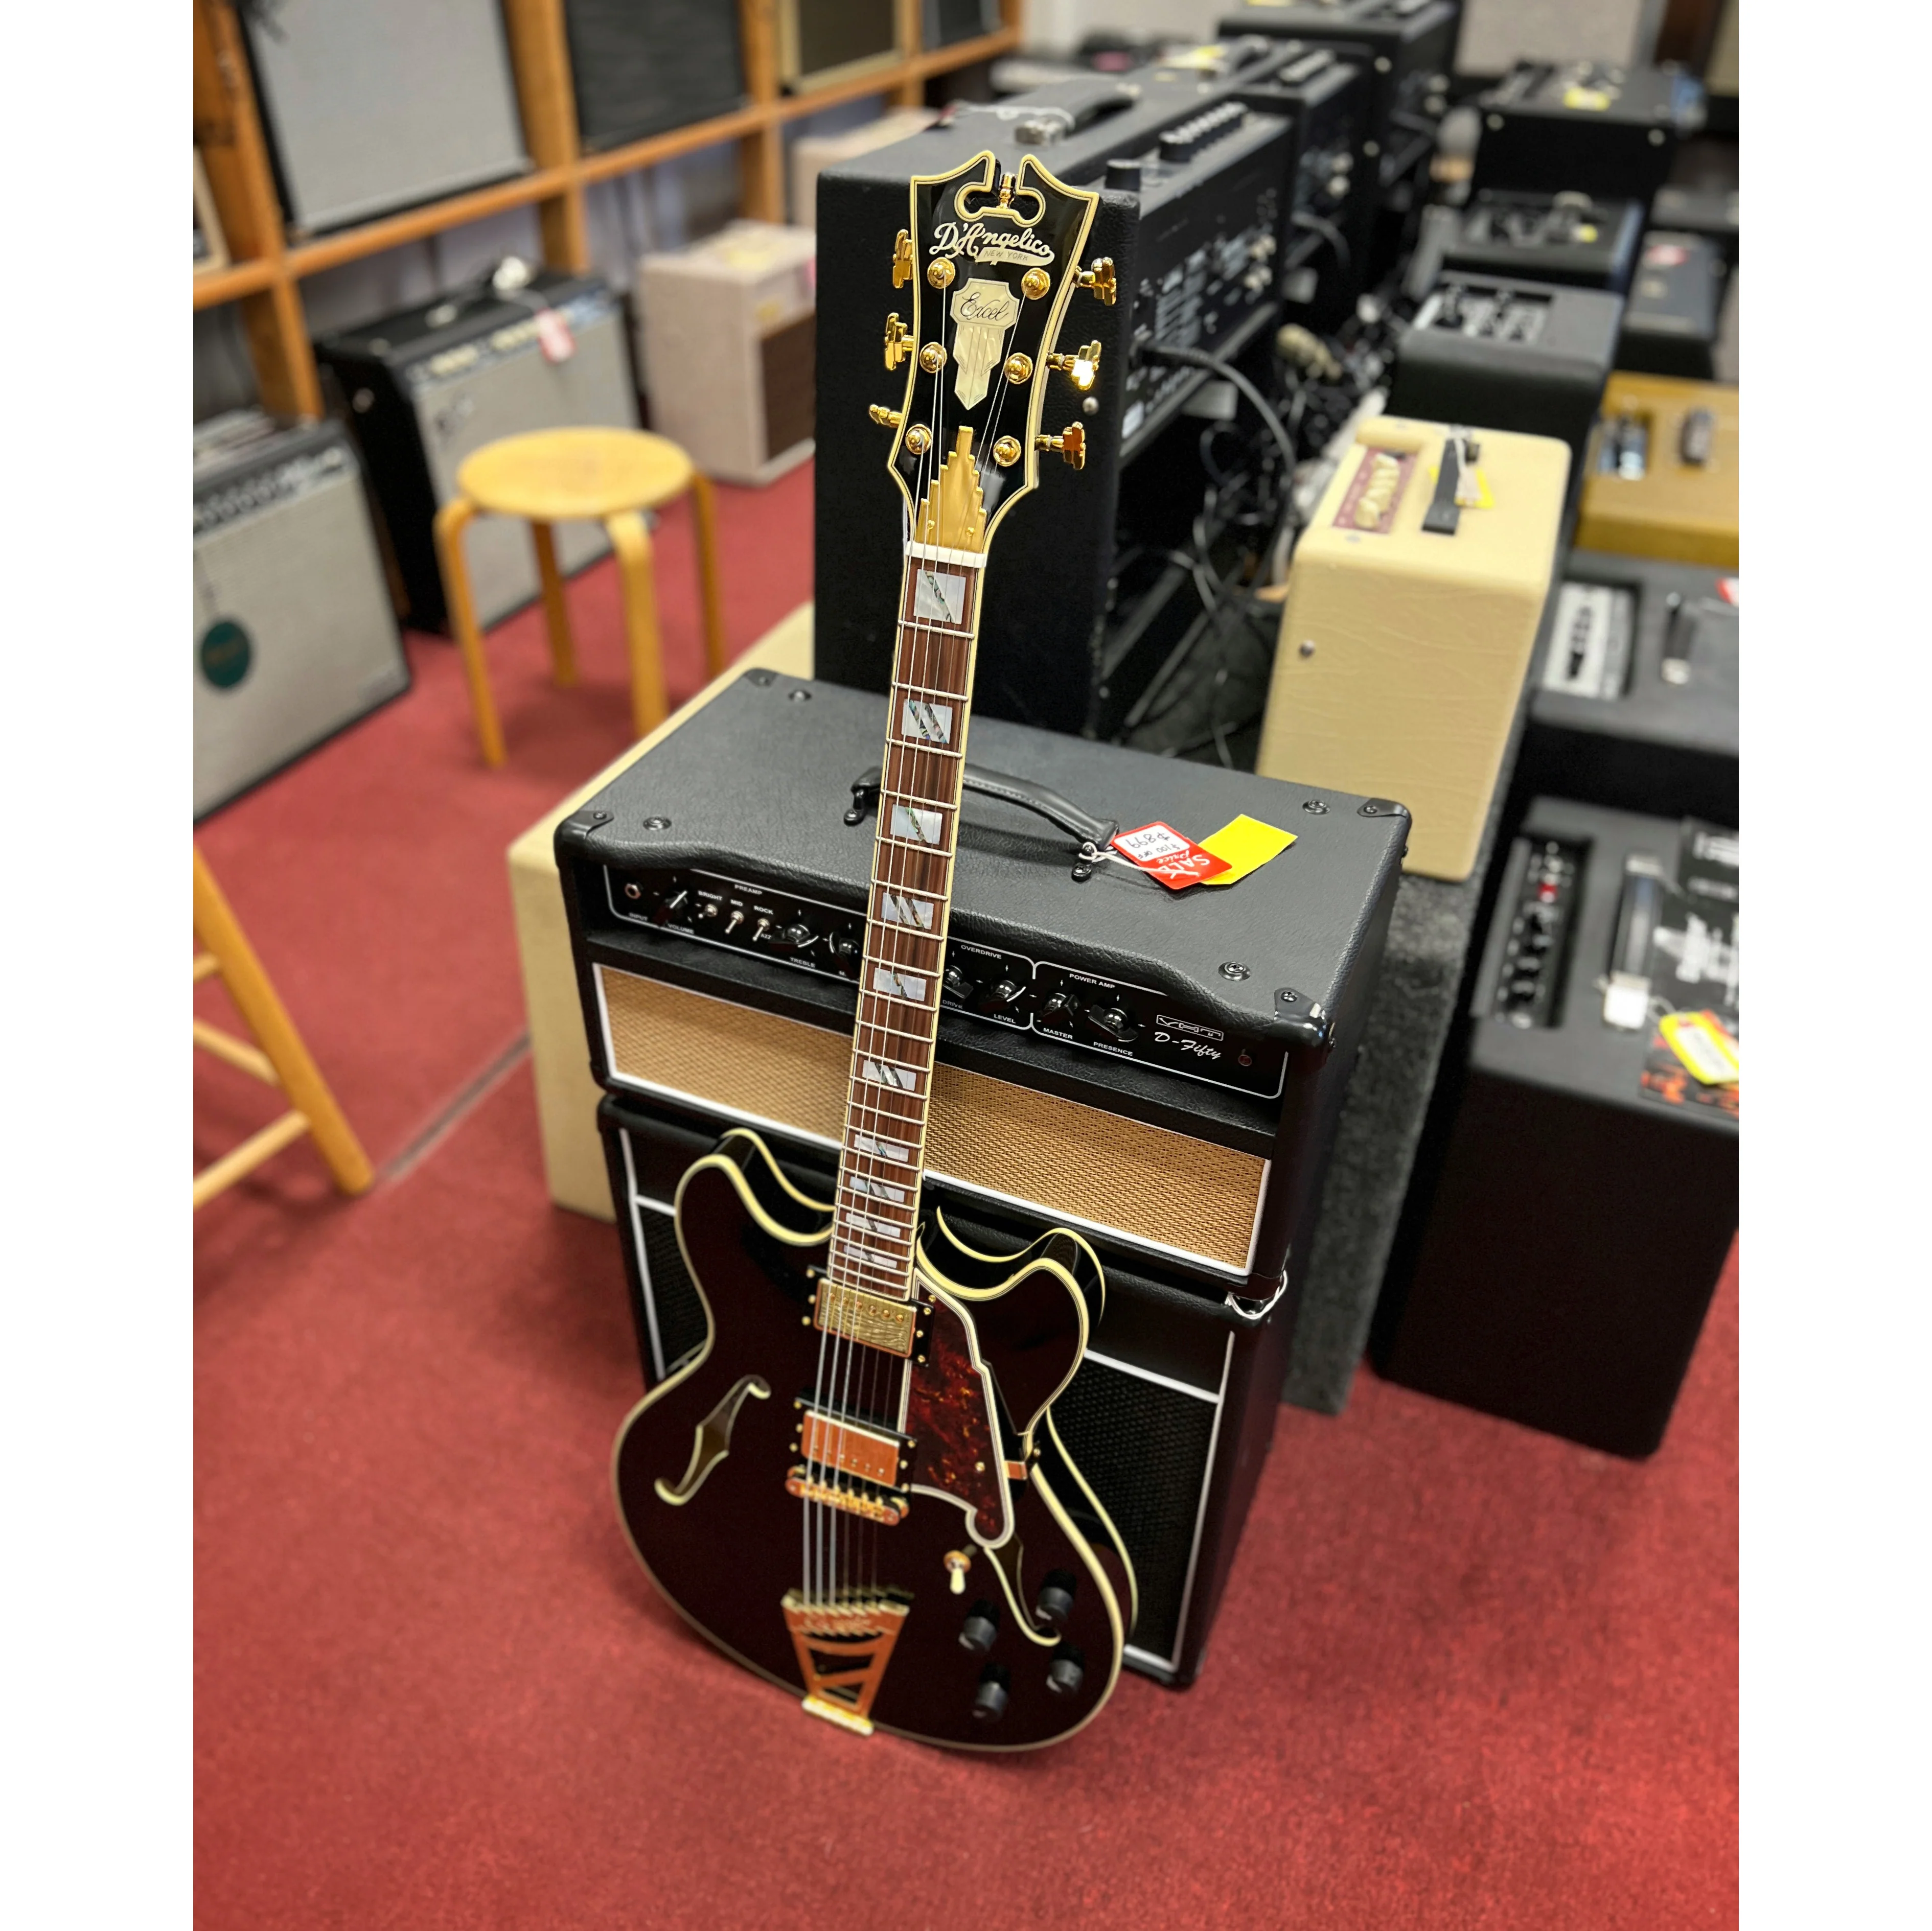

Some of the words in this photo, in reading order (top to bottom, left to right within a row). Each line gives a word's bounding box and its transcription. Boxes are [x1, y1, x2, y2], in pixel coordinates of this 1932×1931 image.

[929, 222, 1052, 259] D'Angelico
[983, 249, 1004, 258] NEW
[1007, 251, 1029, 261] YORK
[960, 292, 1009, 321] Excel
[1125, 832, 1170, 848] $899
[1156, 843, 1180, 853] $100
[734, 883, 763, 895] PREAMP
[698, 890, 723, 901] BRIGHT
[753, 905, 773, 915] ROCK
[629, 912, 648, 921] INPUT
[667, 923, 695, 935] VOLUME
[960, 944, 1002, 960] OVERDRIVE
[789, 957, 816, 968] TREBLE
[1069, 973, 1097, 985] POWER
[1098, 981, 1116, 989] AMP
[942, 999, 963, 1009] DRIVE
[994, 1013, 1016, 1024] LEVEL
[1043, 1028, 1073, 1040] MASTER
[1093, 1041, 1133, 1057] PRESENCE
[1154, 1031, 1222, 1060] D-Fifty
